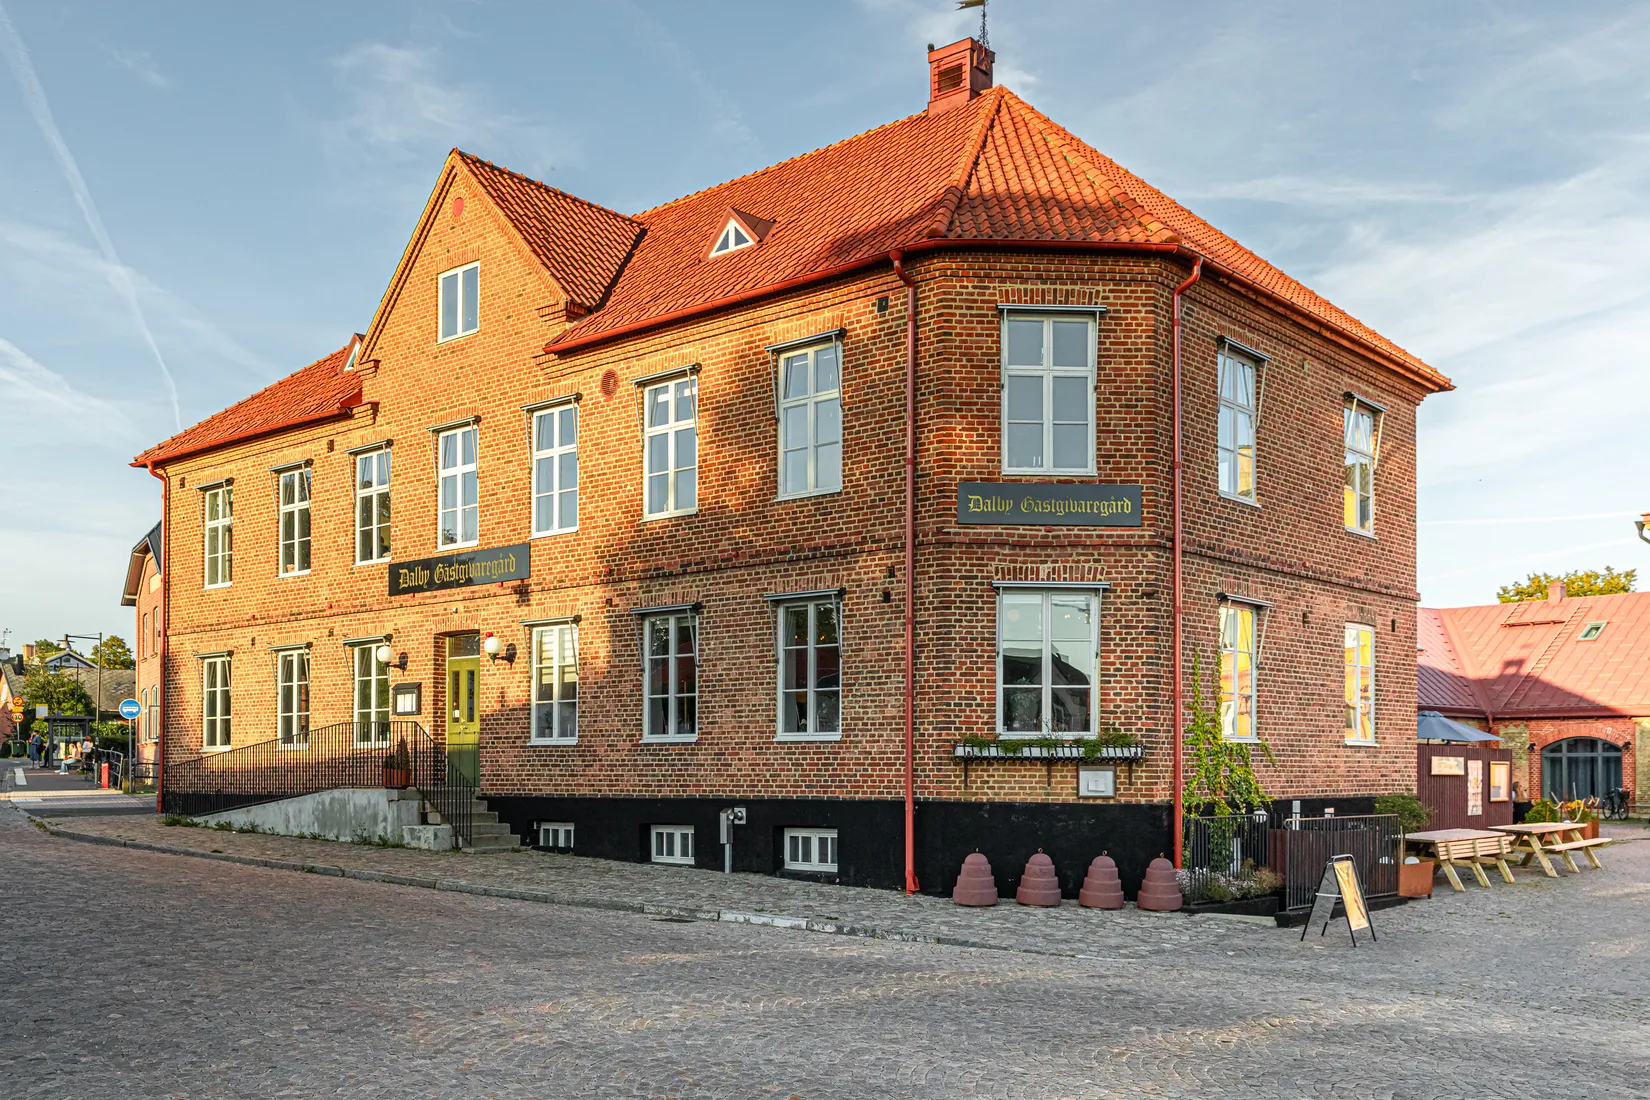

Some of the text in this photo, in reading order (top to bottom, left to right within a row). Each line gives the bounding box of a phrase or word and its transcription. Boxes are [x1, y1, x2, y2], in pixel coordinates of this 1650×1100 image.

[967, 495, 1014, 516] Dalby
[398, 553, 516, 589] Dalby Gästgivaregård
